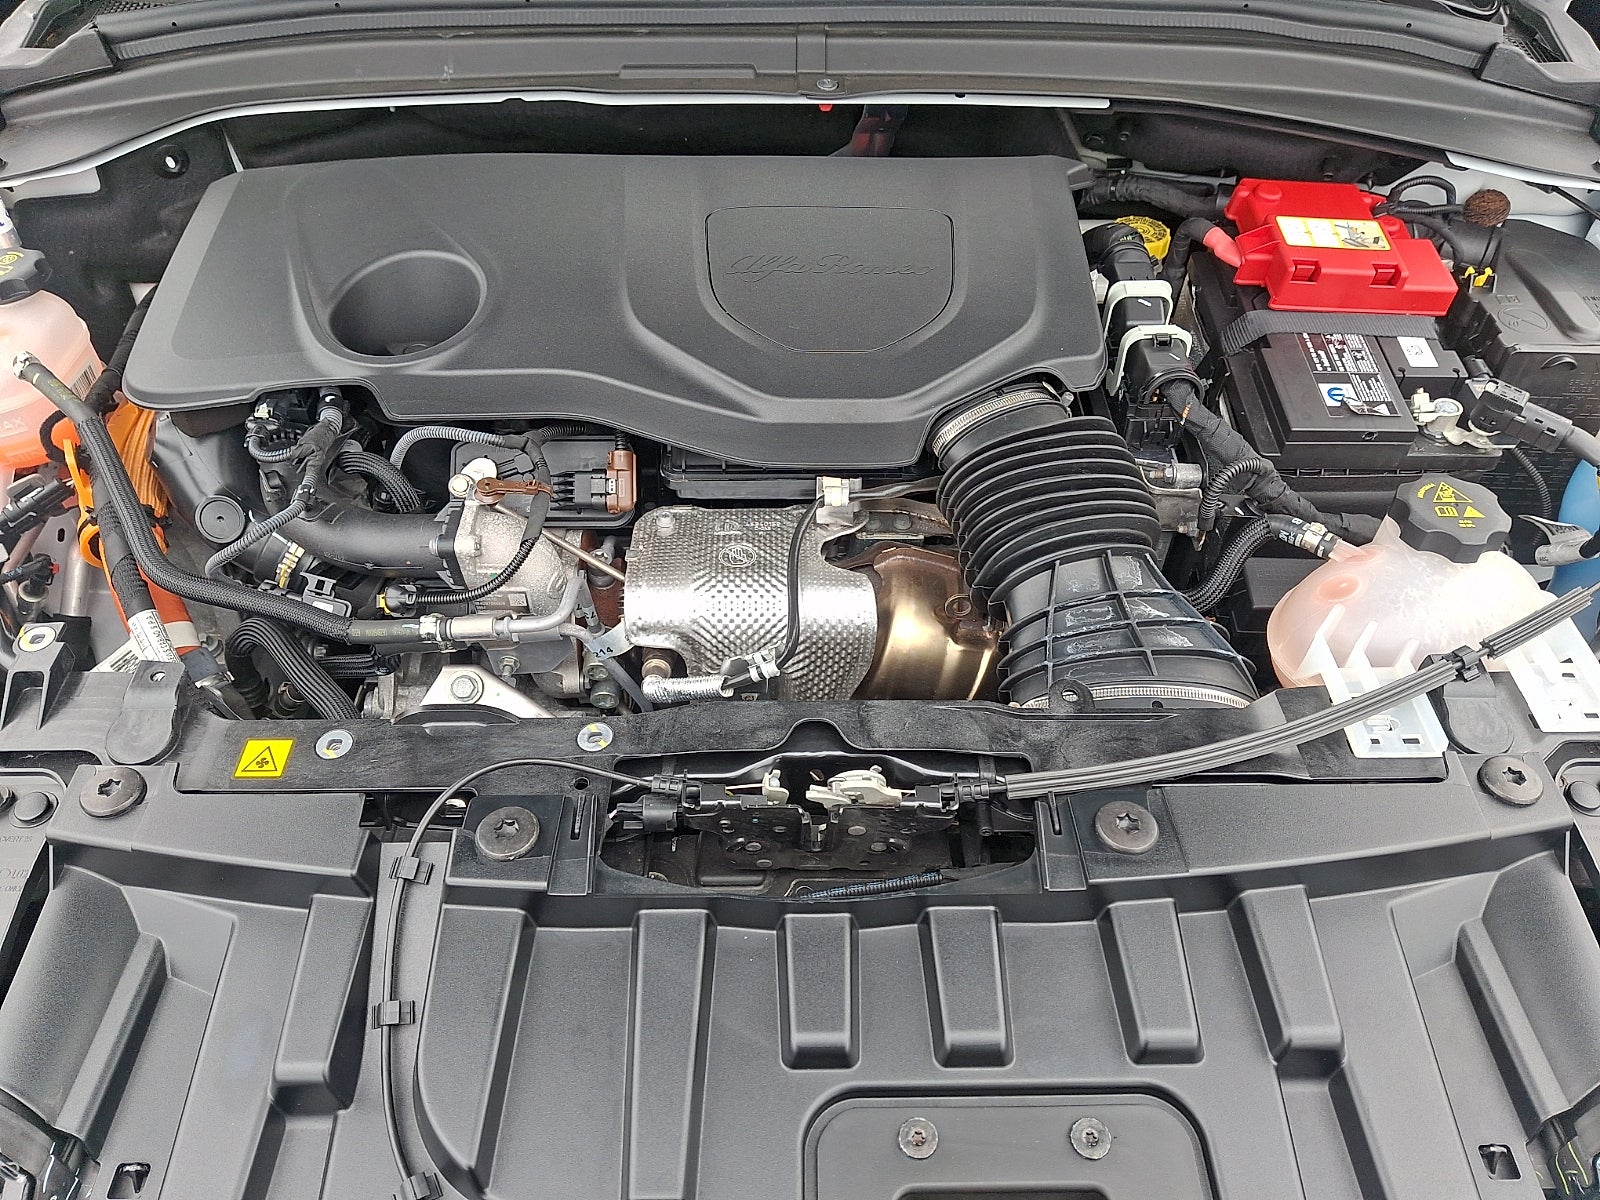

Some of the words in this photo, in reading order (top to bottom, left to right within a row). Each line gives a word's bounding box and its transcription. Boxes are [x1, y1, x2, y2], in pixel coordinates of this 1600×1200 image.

[726, 254, 814, 283] Alfa
[814, 253, 936, 276] Romeo
[593, 646, 614, 658] 214
